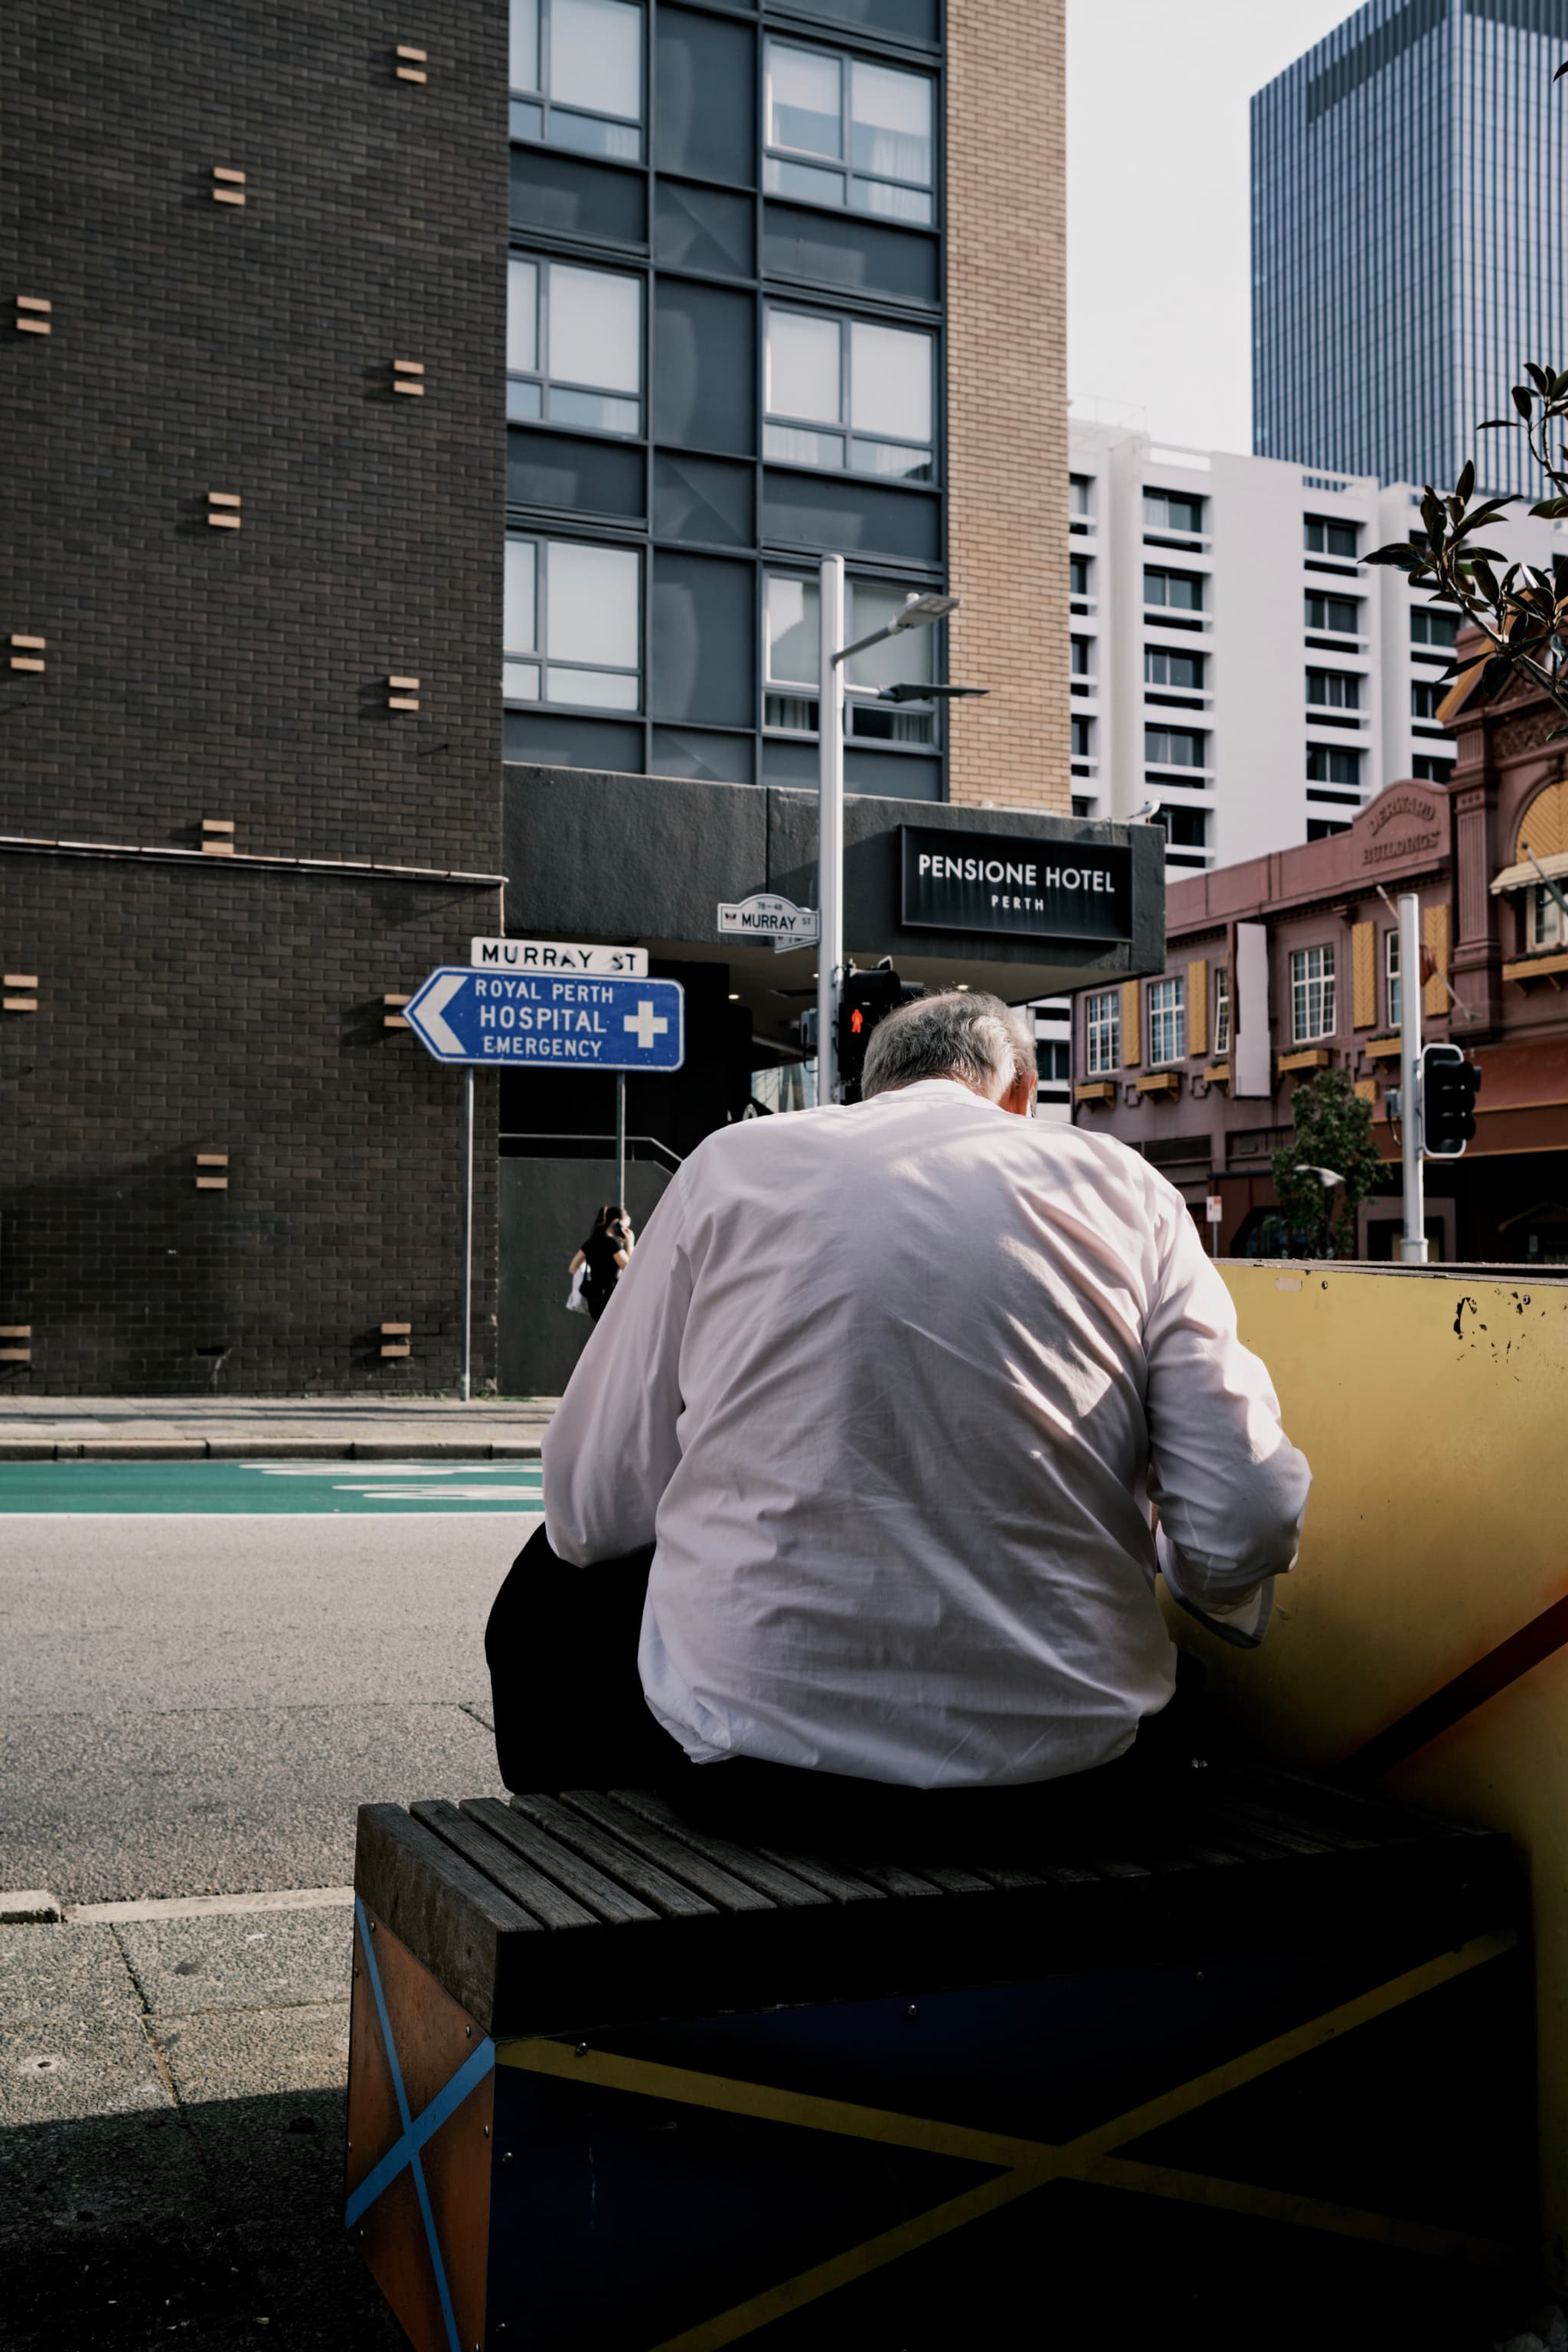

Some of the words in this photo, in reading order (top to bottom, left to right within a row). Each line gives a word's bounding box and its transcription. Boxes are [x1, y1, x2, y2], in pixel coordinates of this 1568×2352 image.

[1362, 831, 1441, 866] BUILDINGS
[919, 854, 1037, 887] PENSIONE
[1046, 866, 1116, 893] HOTEL
[991, 894, 1044, 911] PERTH
[742, 913, 796, 930] MURRAY
[482, 944, 593, 969] MURRAY
[612, 954, 637, 972] ST
[475, 980, 541, 1000] ROYAL
[552, 983, 613, 1003] PERTH
[480, 1005, 607, 1033] HOSPITAL
[483, 1036, 603, 1057] EMERGENCY
